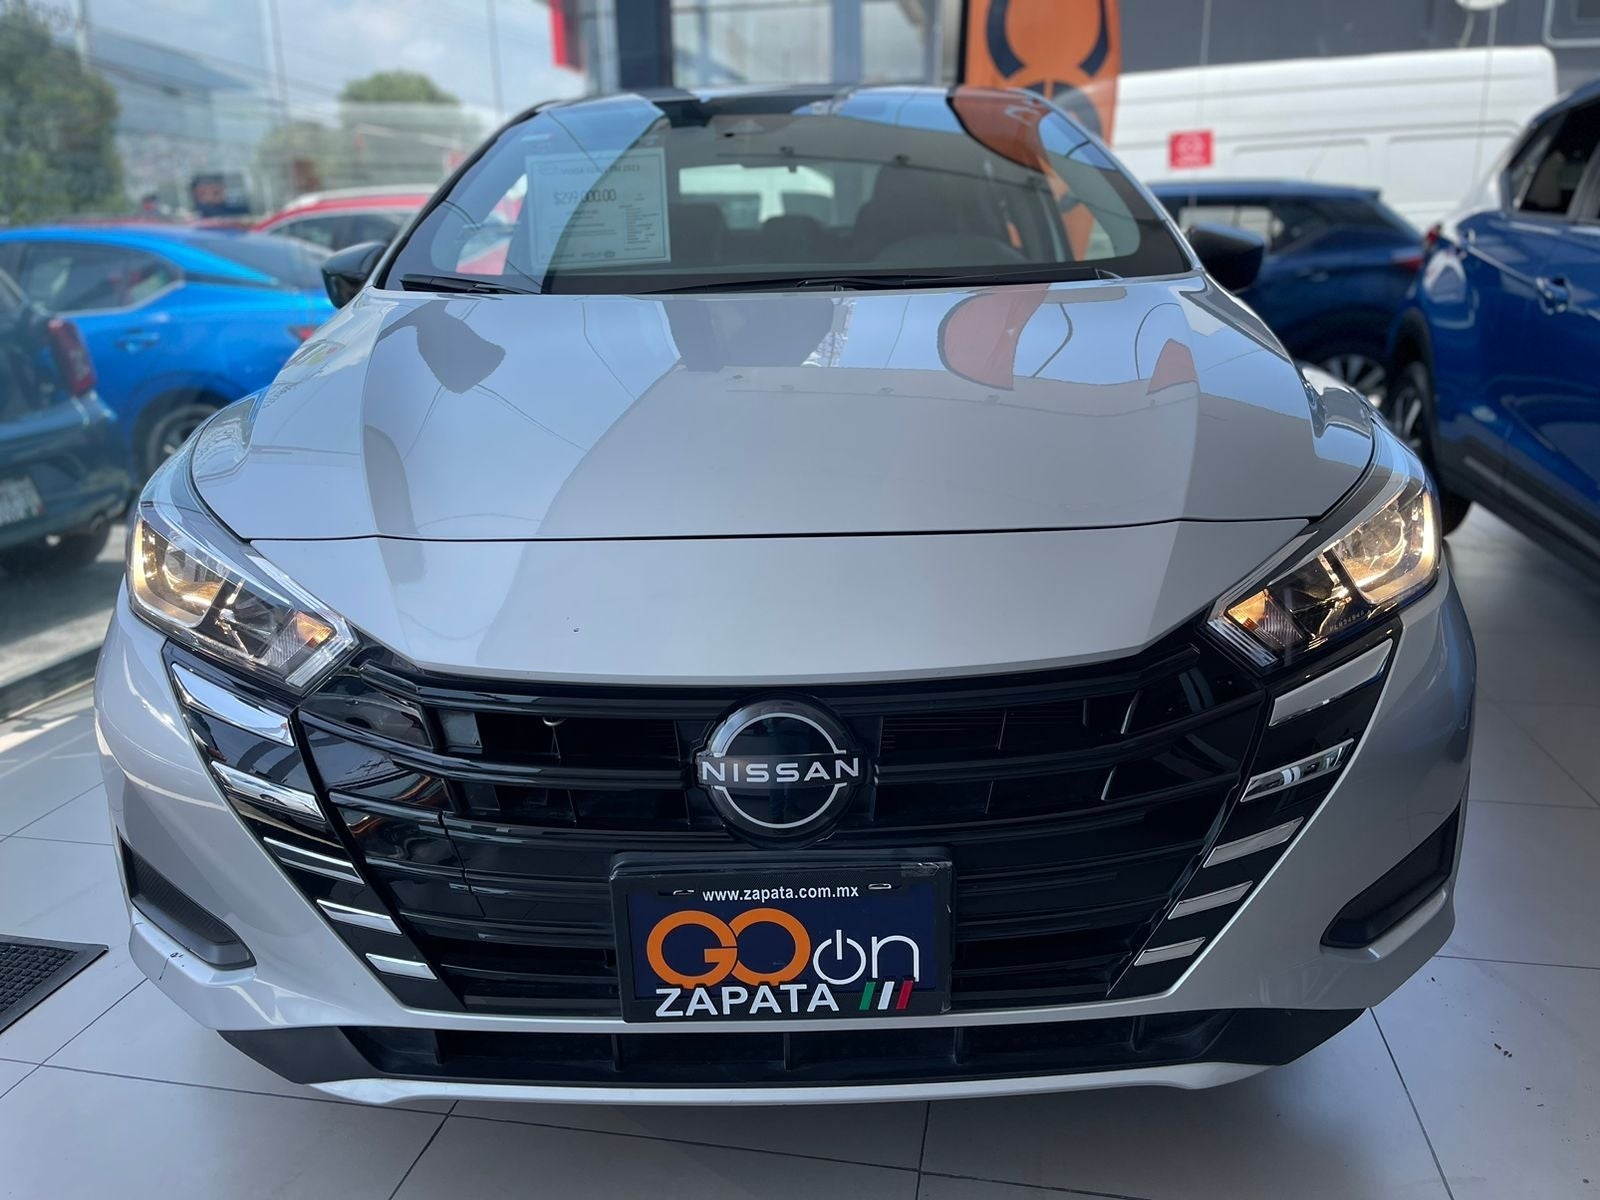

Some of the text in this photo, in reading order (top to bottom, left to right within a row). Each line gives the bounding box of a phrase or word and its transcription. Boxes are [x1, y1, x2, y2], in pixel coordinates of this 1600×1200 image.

[702, 757, 859, 783] NISSAN
[702, 885, 859, 903] www.zapata.com.mx
[655, 983, 840, 1017] ZAPATA
